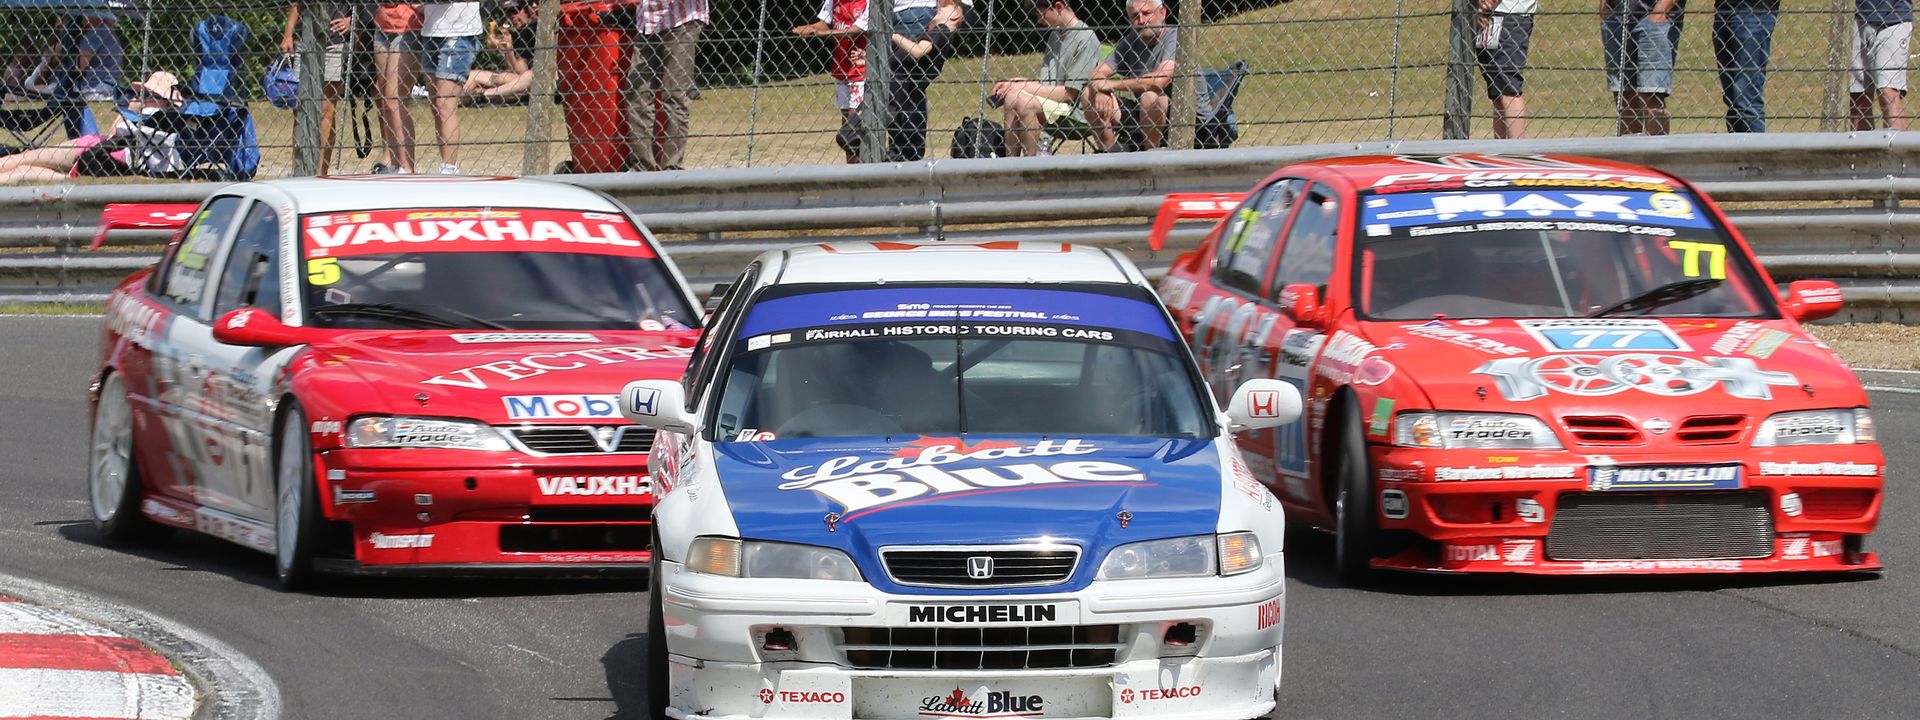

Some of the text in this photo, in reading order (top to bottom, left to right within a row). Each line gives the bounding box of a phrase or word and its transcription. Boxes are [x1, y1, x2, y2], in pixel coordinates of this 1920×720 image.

[305, 220, 642, 248] VAUXHALL
[1668, 240, 1727, 280] 77
[307, 257, 341, 287] 5
[863, 309, 928, 319] GEORGE
[973, 310, 1048, 320] FESTIVAL
[883, 325, 970, 336] HISTORIC
[974, 325, 1058, 337] TOURING
[1062, 327, 1114, 341] CARS
[1570, 329, 1647, 349] 77
[394, 433, 473, 443] Trader
[1453, 429, 1532, 439] Trader
[1616, 466, 1737, 482] MICHELIN
[812, 460, 1148, 516] Blue
[909, 604, 1056, 623] MICHELIN
[1257, 599, 1281, 631] RICOH
[780, 690, 845, 705] TEXACO
[986, 691, 1044, 714] Blue
[1140, 685, 1202, 701] TEXACO
